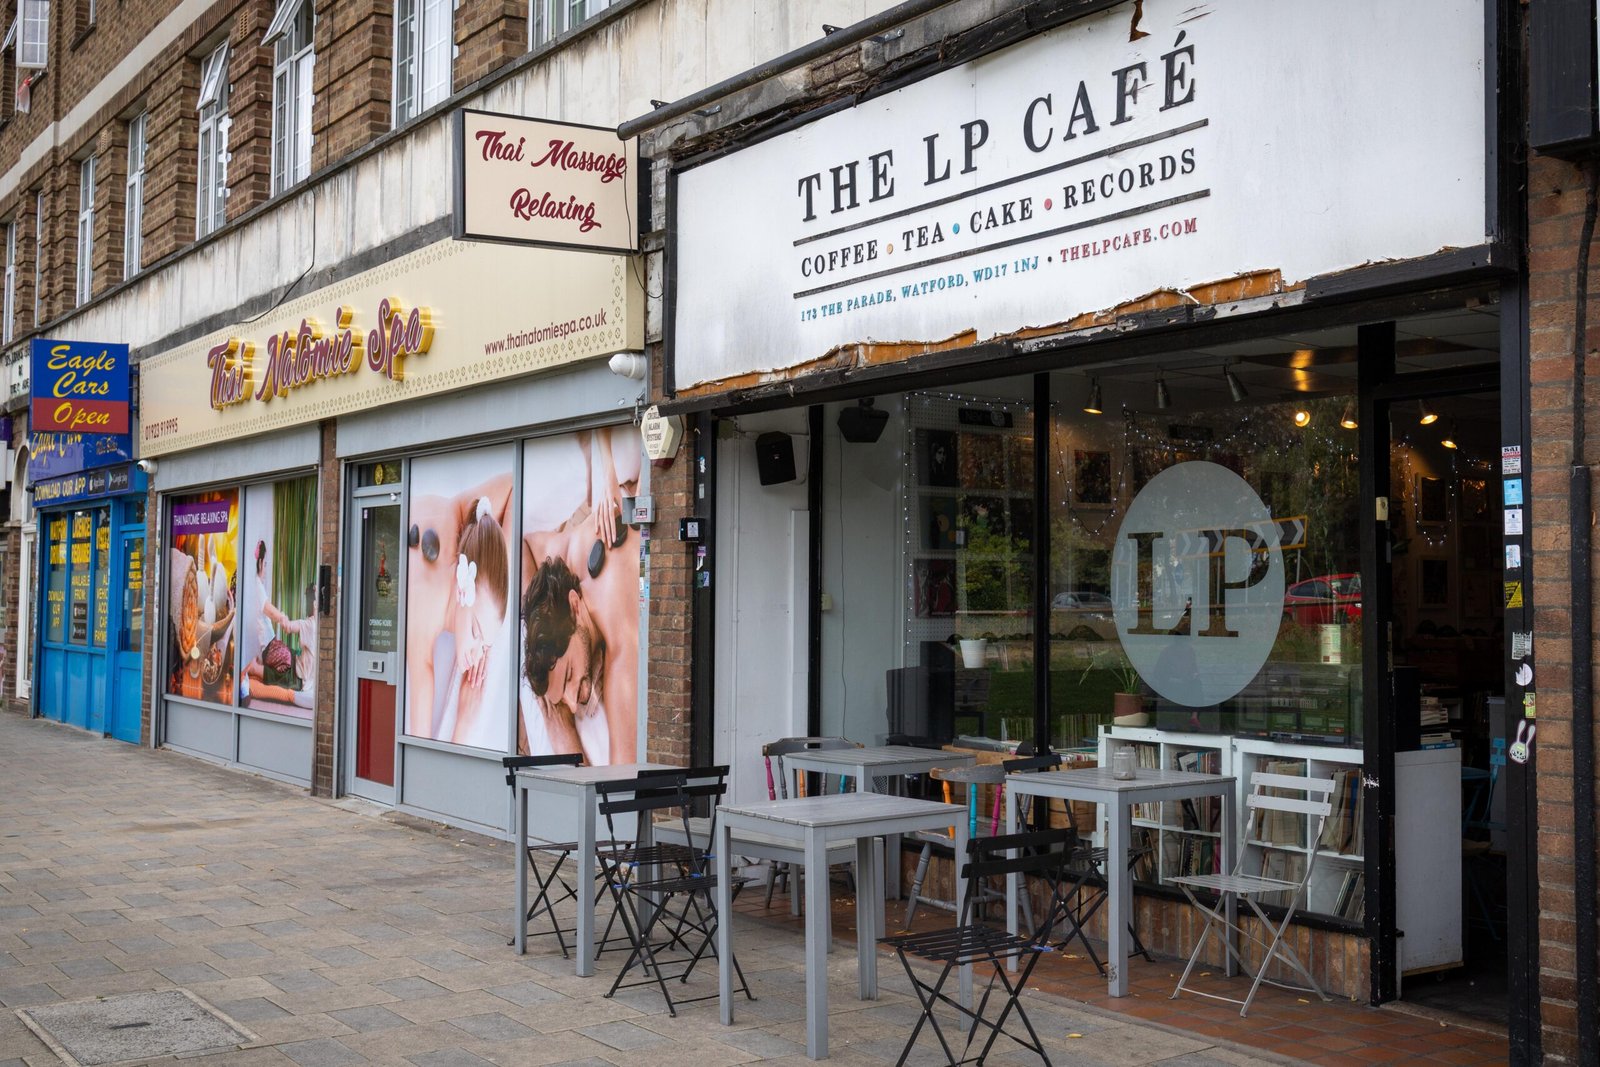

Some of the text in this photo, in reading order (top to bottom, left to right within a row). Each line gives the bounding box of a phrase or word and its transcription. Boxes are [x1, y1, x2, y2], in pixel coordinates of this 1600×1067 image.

[798, 30, 1197, 222] THE LP CAFÉ
[475, 130, 627, 183] Thai Massage
[509, 188, 602, 233] Relaxing
[801, 148, 1197, 278] COFFEE TEA CAKE RECORDS
[801, 217, 1199, 323] 173 THE PARADE, WATFORD, WD17 1NJ THELPCAFE.COM
[484, 308, 608, 356] www.thainatomiespa.co.uk
[47, 345, 116, 377] Eagle
[207, 337, 250, 411] Thai
[367, 298, 428, 381] Spa
[53, 371, 109, 398] Cars
[54, 402, 110, 429] Open
[145, 422, 160, 440] 01923
[648, 422, 660, 430] ALARM
[647, 433, 662, 442] SYSTEMS
[35, 477, 86, 501] DOWNLOAD OUR APP
[201, 512, 220, 524] RELAXING
[48, 590, 65, 601] DOWNLOA
[1127, 528, 1270, 638] LP
